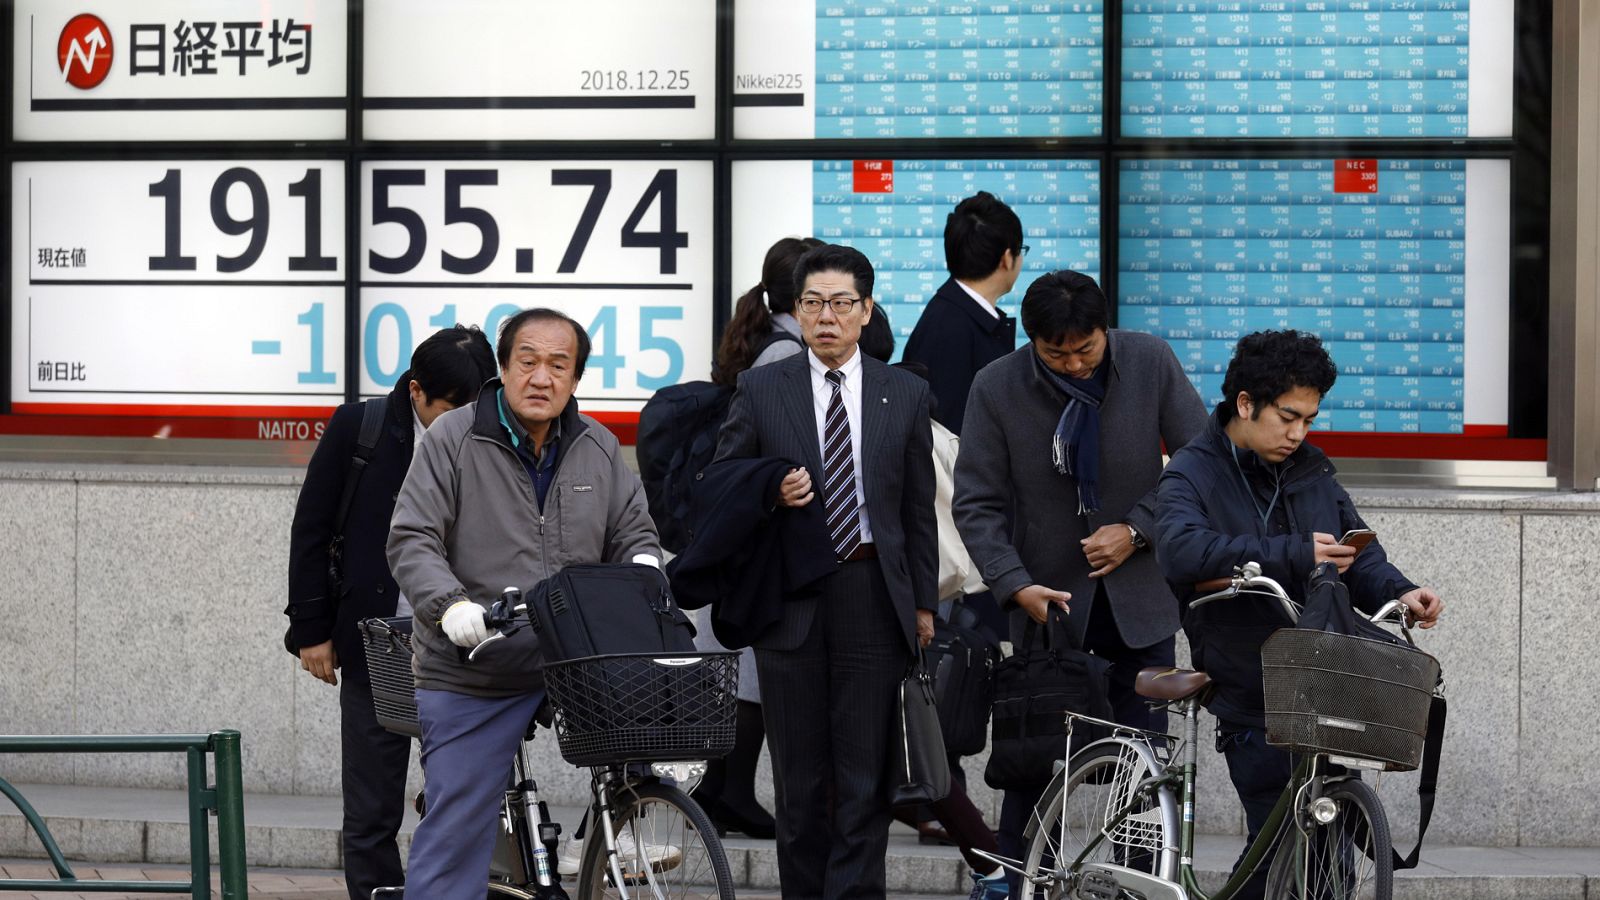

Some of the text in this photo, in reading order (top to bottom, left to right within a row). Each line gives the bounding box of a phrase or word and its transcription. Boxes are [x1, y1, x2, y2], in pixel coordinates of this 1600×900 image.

[128, 19, 312, 76] 日経平均
[1394, 36, 1412, 44] AGC
[581, 70, 690, 90] 2018.12.25
[736, 74, 803, 89] Nikkei225
[37, 248, 87, 267] 現在値
[37, 362, 86, 381] 前日比
[258, 421, 309, 439] NAITO
